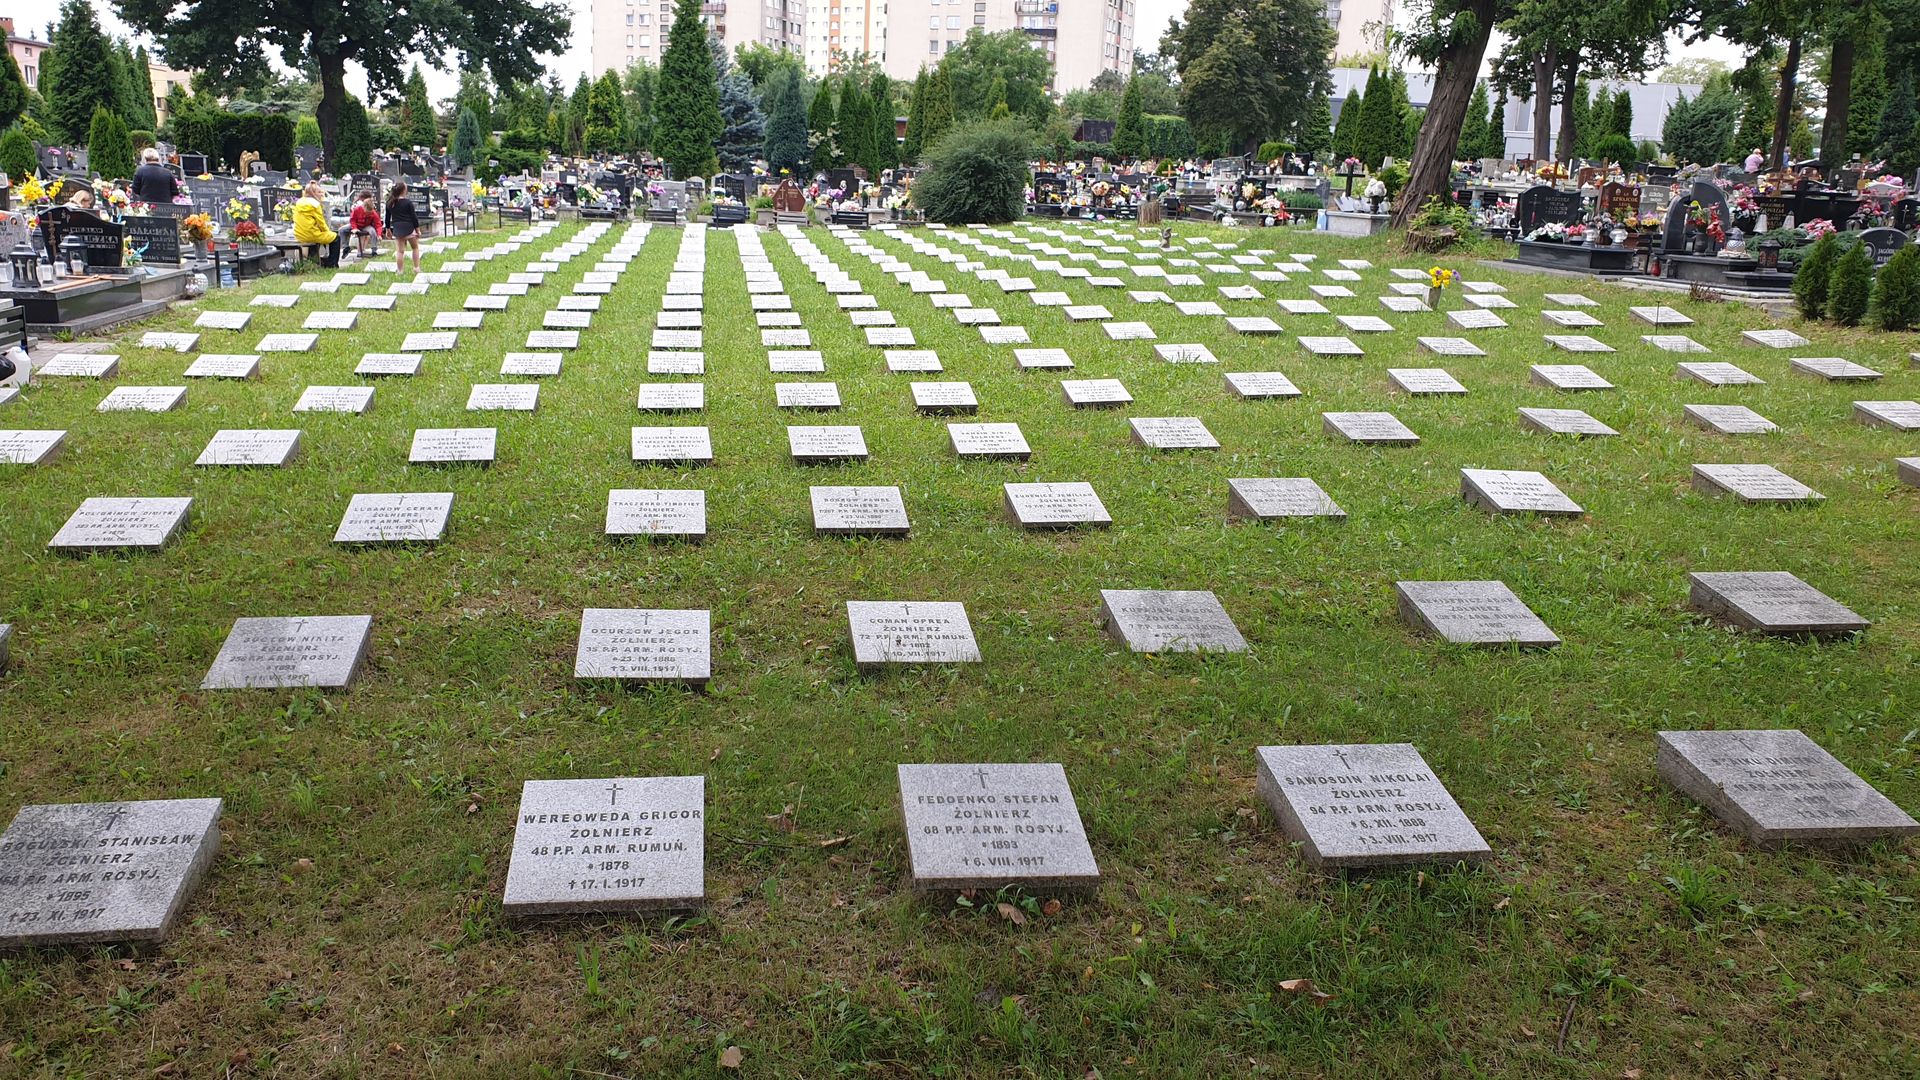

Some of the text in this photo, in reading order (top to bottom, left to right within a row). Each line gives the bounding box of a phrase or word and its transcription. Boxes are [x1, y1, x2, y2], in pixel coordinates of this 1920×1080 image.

[1368, 772, 1432, 783] NIKOLAI
[1003, 793, 1060, 804] STEFAN
[1328, 785, 1406, 799] ŻOŁNIERZ
[952, 805, 1031, 819] ŻOŁNIERZ
[1308, 801, 1448, 815] 94 P.P. ARM. ROSYJ.
[522, 809, 701, 824] WEREOWEDA GRIGOR
[922, 824, 1069, 835] 68 P.P. ARM. ROSYJ.
[1357, 819, 1374, 829] 6.
[1372, 818, 1398, 828] XII.
[98, 834, 195, 848] STANISŁAW
[990, 840, 1019, 849] 1893
[1367, 833, 1441, 845] 3. VIII. 1917
[530, 838, 687, 856] 48 P.P. ARM. RUMUŃ.
[46, 852, 134, 867] ŻOŁNIERZ
[598, 860, 630, 871] 1878
[972, 856, 1047, 867] 6. VIII. 1917
[53, 872, 94, 884] ARM.
[102, 869, 160, 882] ROSYJ.
[579, 877, 645, 890] 17. I. 1917
[58, 890, 92, 902] 1895
[22, 908, 106, 922] 23. XI. 1917
